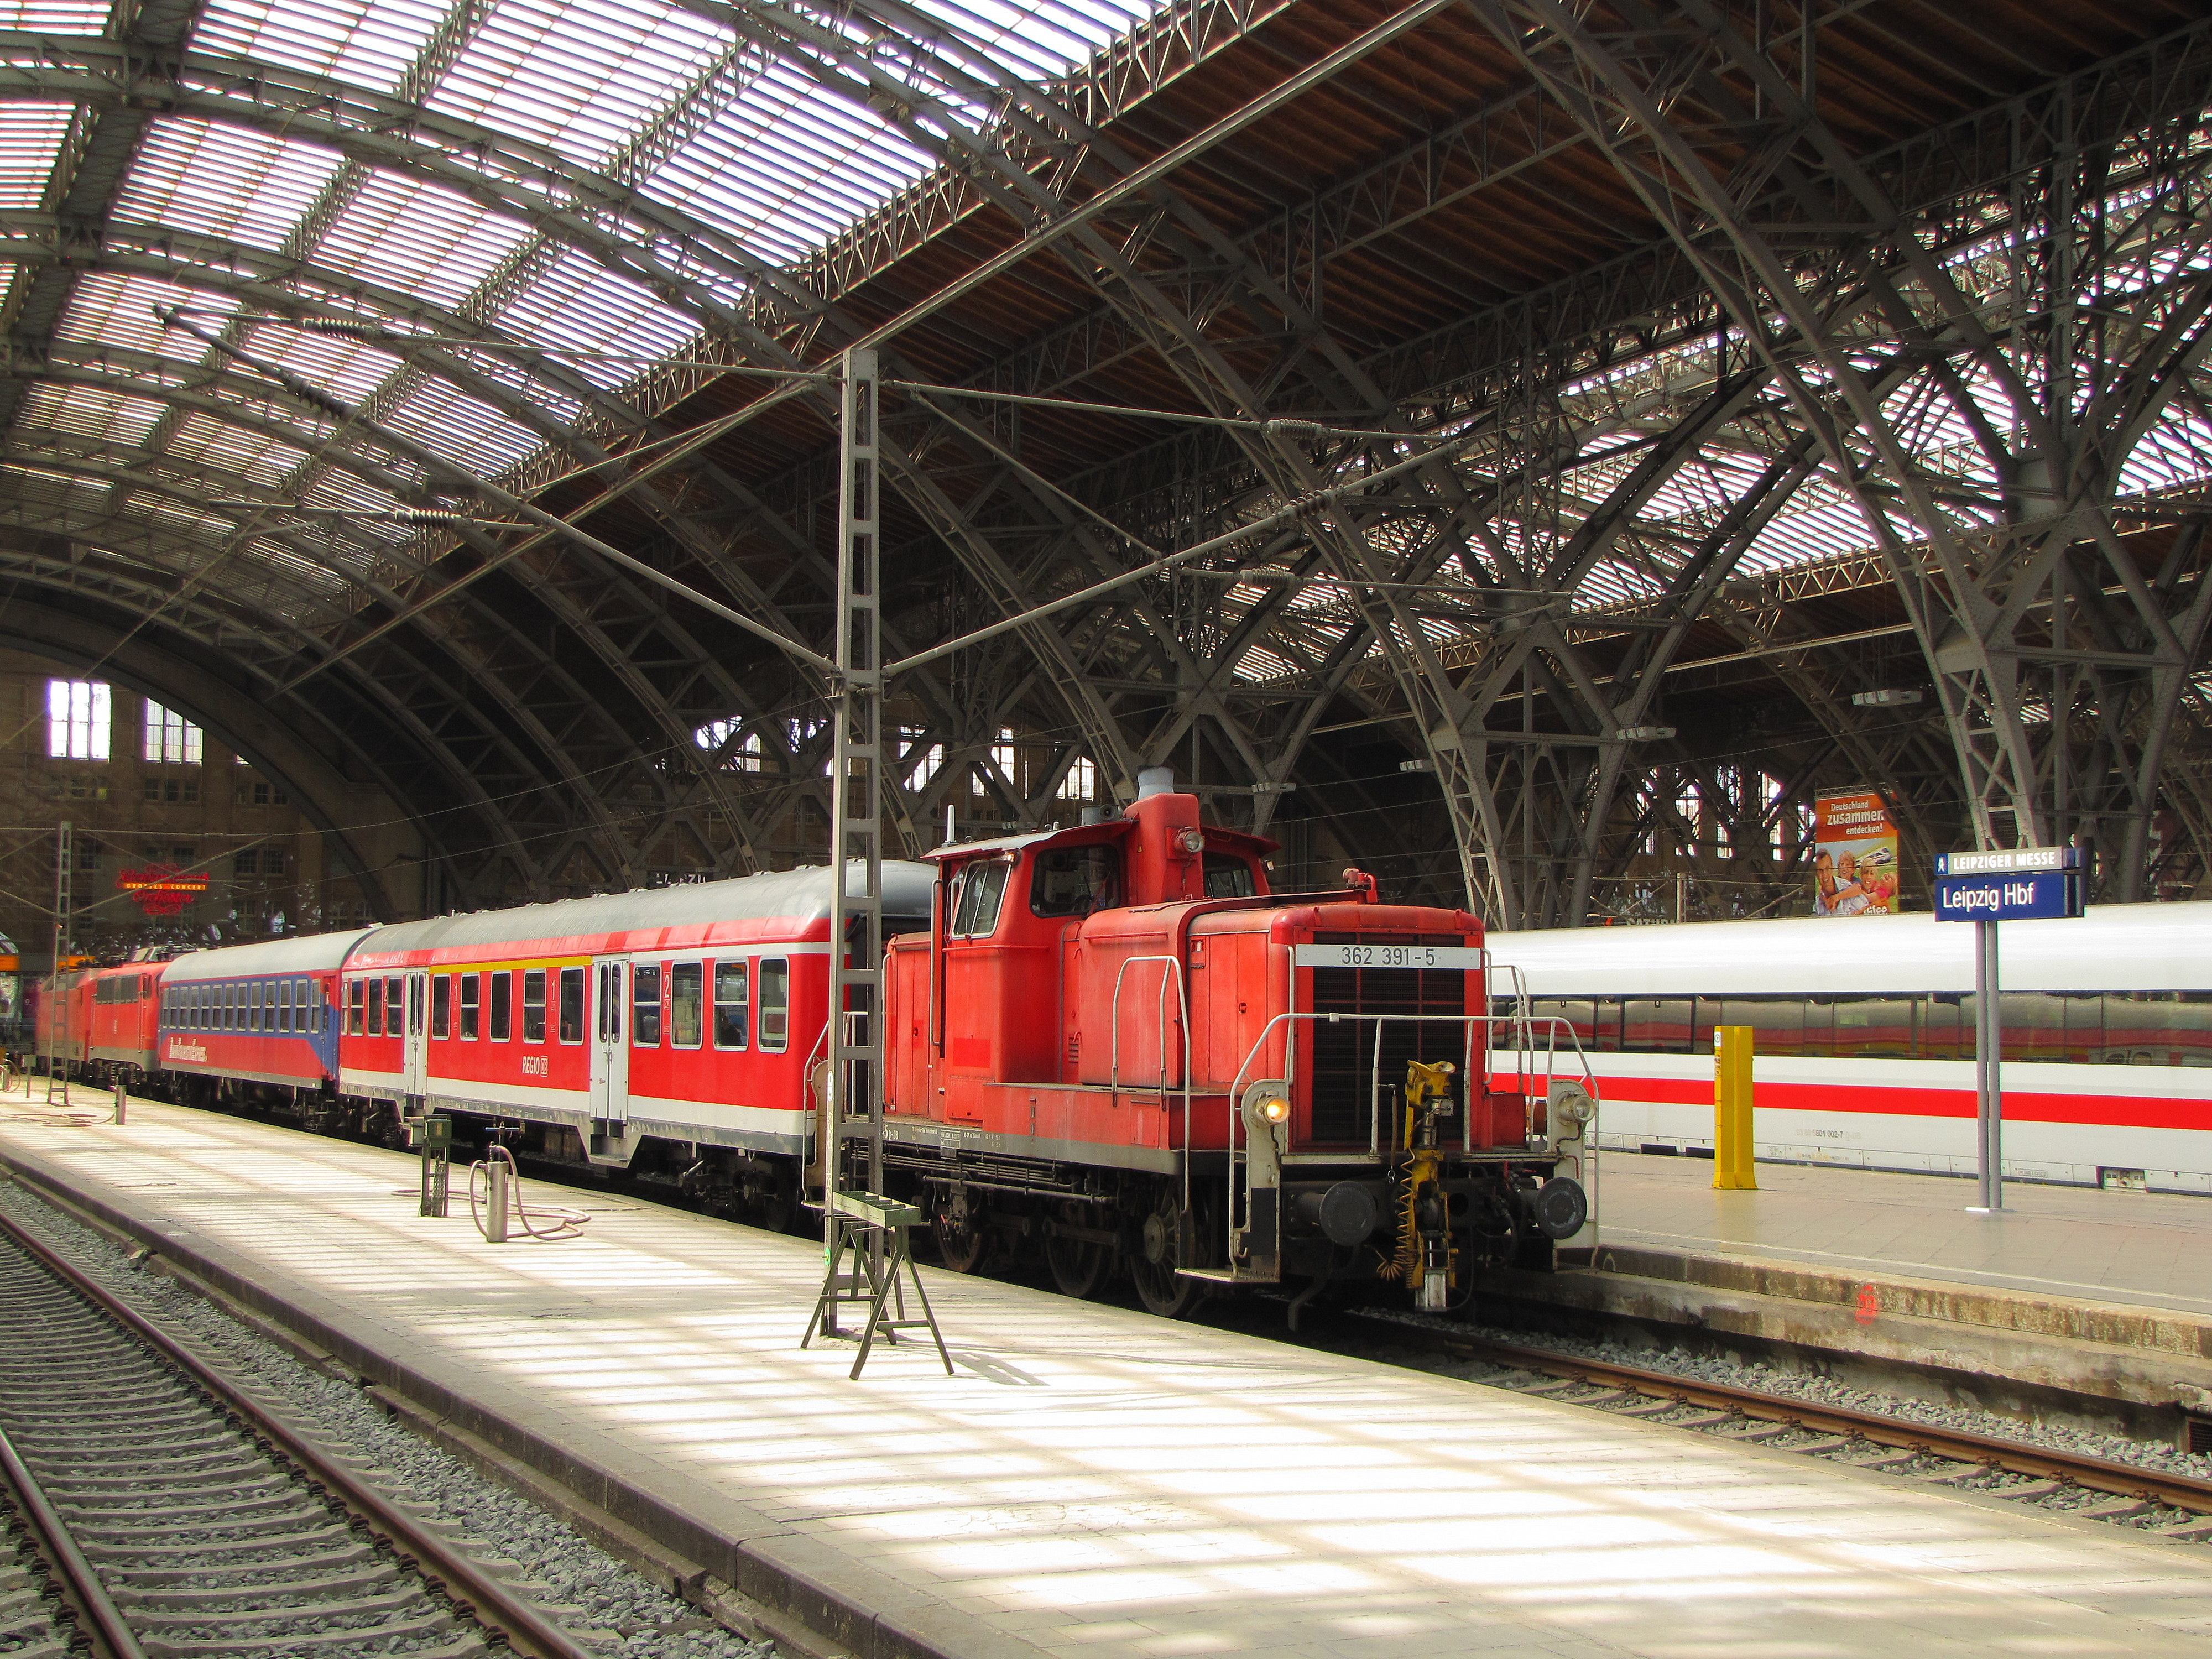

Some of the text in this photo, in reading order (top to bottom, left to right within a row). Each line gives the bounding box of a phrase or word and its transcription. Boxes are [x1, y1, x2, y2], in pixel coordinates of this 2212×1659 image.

[1830, 800, 1869, 811] Deutschland
[1827, 809, 1884, 826] zusammen
[1845, 823, 1883, 836] entdecken!
[1953, 852, 2055, 870] LEIPZIGER MESSE
[1943, 881, 2035, 912] Leipzig Hbf
[1342, 946, 1435, 966] 362 391-5
[551, 979, 555, 1000] 1
[664, 974, 670, 998] 2
[522, 1056, 540, 1075] REGIO
[1827, 1130, 1843, 1139] 002-7
